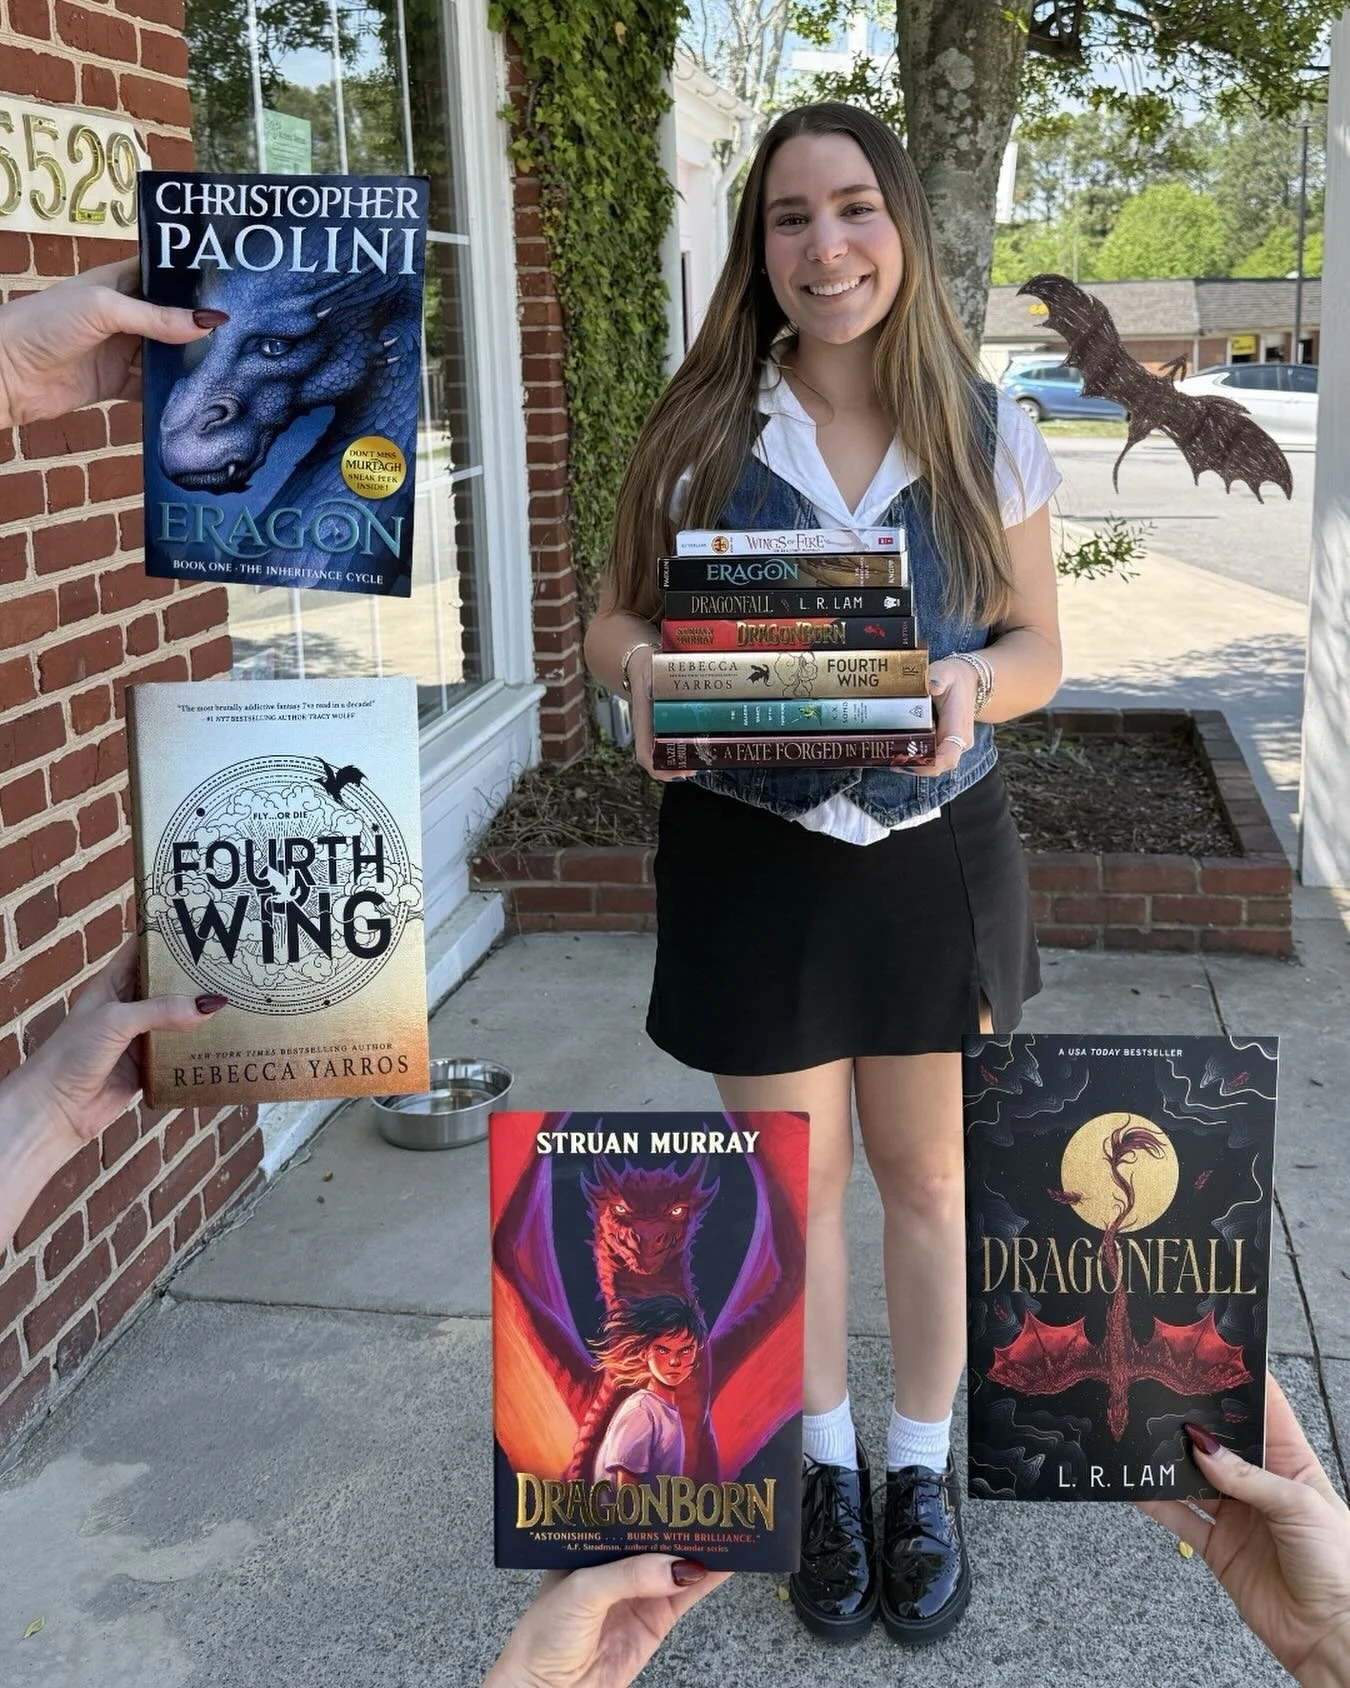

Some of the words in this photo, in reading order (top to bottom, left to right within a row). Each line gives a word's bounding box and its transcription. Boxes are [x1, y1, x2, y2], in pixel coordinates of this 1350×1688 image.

[155, 181, 420, 219] CHRISTOPHER
[156, 222, 419, 275] PAOLINI
[377, 451, 396, 459] MISS
[346, 458, 402, 473] MURTAGH
[348, 473, 375, 482] SNEAK
[378, 475, 398, 483] PEEK
[357, 482, 389, 491] INSIDE!
[157, 500, 405, 559] ERAGON
[745, 534, 787, 550] WINGS
[796, 533, 825, 549] FIRE
[173, 559, 207, 573] BOOK
[208, 562, 232, 573] ONE
[240, 563, 262, 575] THE
[266, 565, 343, 581] INHERITANCE
[346, 572, 384, 585] CYCLE
[706, 559, 799, 586] ERAGON
[691, 595, 774, 614] DRAGONFALL
[800, 597, 810, 610] L.
[816, 597, 828, 610] R.
[834, 596, 863, 609] LAM
[667, 660, 739, 672] REBECCA
[827, 658, 888, 673] FOURTH
[673, 679, 733, 690] YARROS
[837, 673, 879, 687] WING
[196, 704, 214, 712] most
[215, 703, 242, 712] brutally
[244, 703, 274, 711] addictive
[277, 702, 300, 711] fantasy
[316, 701, 331, 709] read
[230, 714, 276, 722] BESTSELLING
[278, 713, 307, 721] AUTHOR
[724, 745, 733, 759] A
[736, 743, 772, 760] FATE
[775, 742, 843, 760] FORGED
[846, 743, 857, 758] IN
[861, 741, 895, 759] FIRE
[293, 810, 308, 820] DIE
[172, 834, 385, 893] FOURTH
[172, 890, 392, 966] WING
[190, 1052, 210, 1060] NEW
[216, 1050, 241, 1059] YORK
[246, 1048, 276, 1057] TIMES
[280, 1045, 347, 1056] BESTSELLING
[351, 1043, 393, 1052] AUTHOR
[1058, 1048, 1065, 1056] A
[1068, 1048, 1087, 1056] USA
[1090, 1048, 1121, 1056] TODAY
[1123, 1048, 1183, 1057] BESTSELLER
[173, 1062, 296, 1087] REBECCA
[307, 1054, 409, 1079] YARROS
[536, 1131, 639, 1154] STRUAN
[650, 1130, 760, 1154] MURRAY
[981, 1236, 1257, 1295] DRAGONFALL
[1058, 1465, 1076, 1488] L.
[1090, 1465, 1111, 1488] R.
[1123, 1464, 1175, 1487] LAM
[515, 1471, 777, 1531] DRAGONBORN
[626, 1532, 659, 1541] BURNS
[663, 1532, 690, 1541] WITH
[583, 1543, 622, 1552] Steadman,
[624, 1543, 647, 1551] author
[650, 1543, 657, 1551] of
[659, 1543, 671, 1551] the
[673, 1543, 704, 1552] Skandar
[706, 1545, 729, 1553] series
